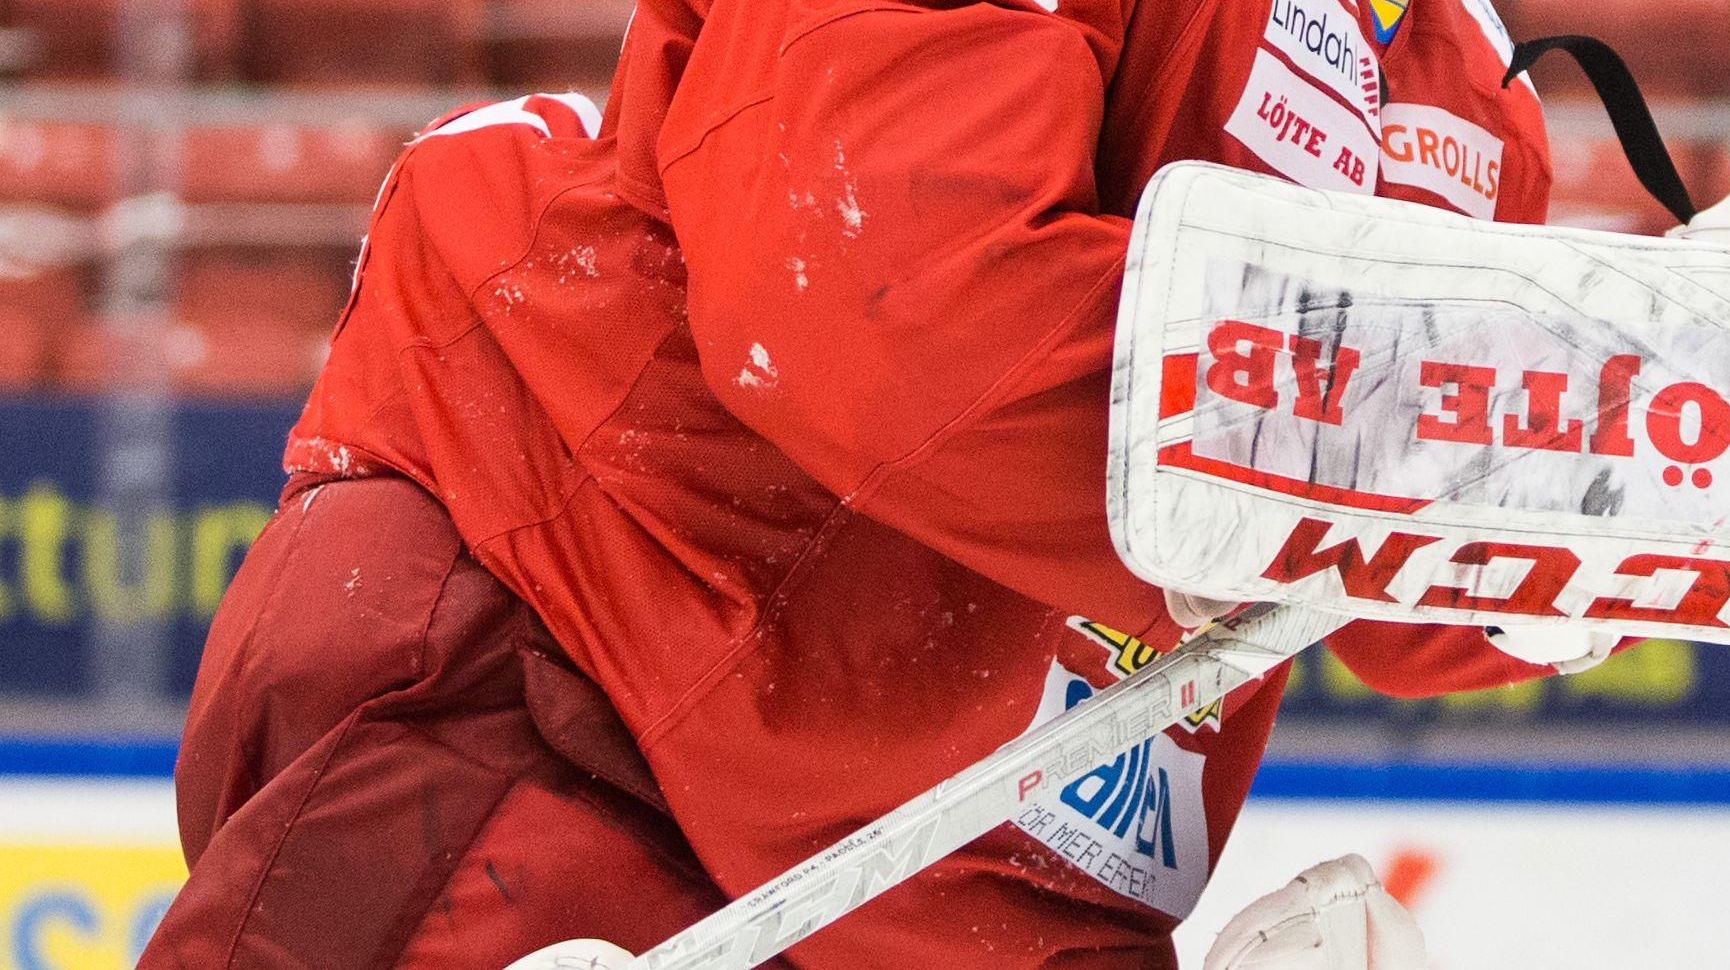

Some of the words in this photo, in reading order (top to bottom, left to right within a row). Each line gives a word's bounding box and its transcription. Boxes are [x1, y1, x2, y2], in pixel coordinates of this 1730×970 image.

[1257, 90, 1328, 158] LÖJTE
[1333, 146, 1366, 187] AB
[1381, 123, 1499, 201] GROLLS
[1206, 318, 1361, 427] AB
[1046, 821, 1103, 870] MER
